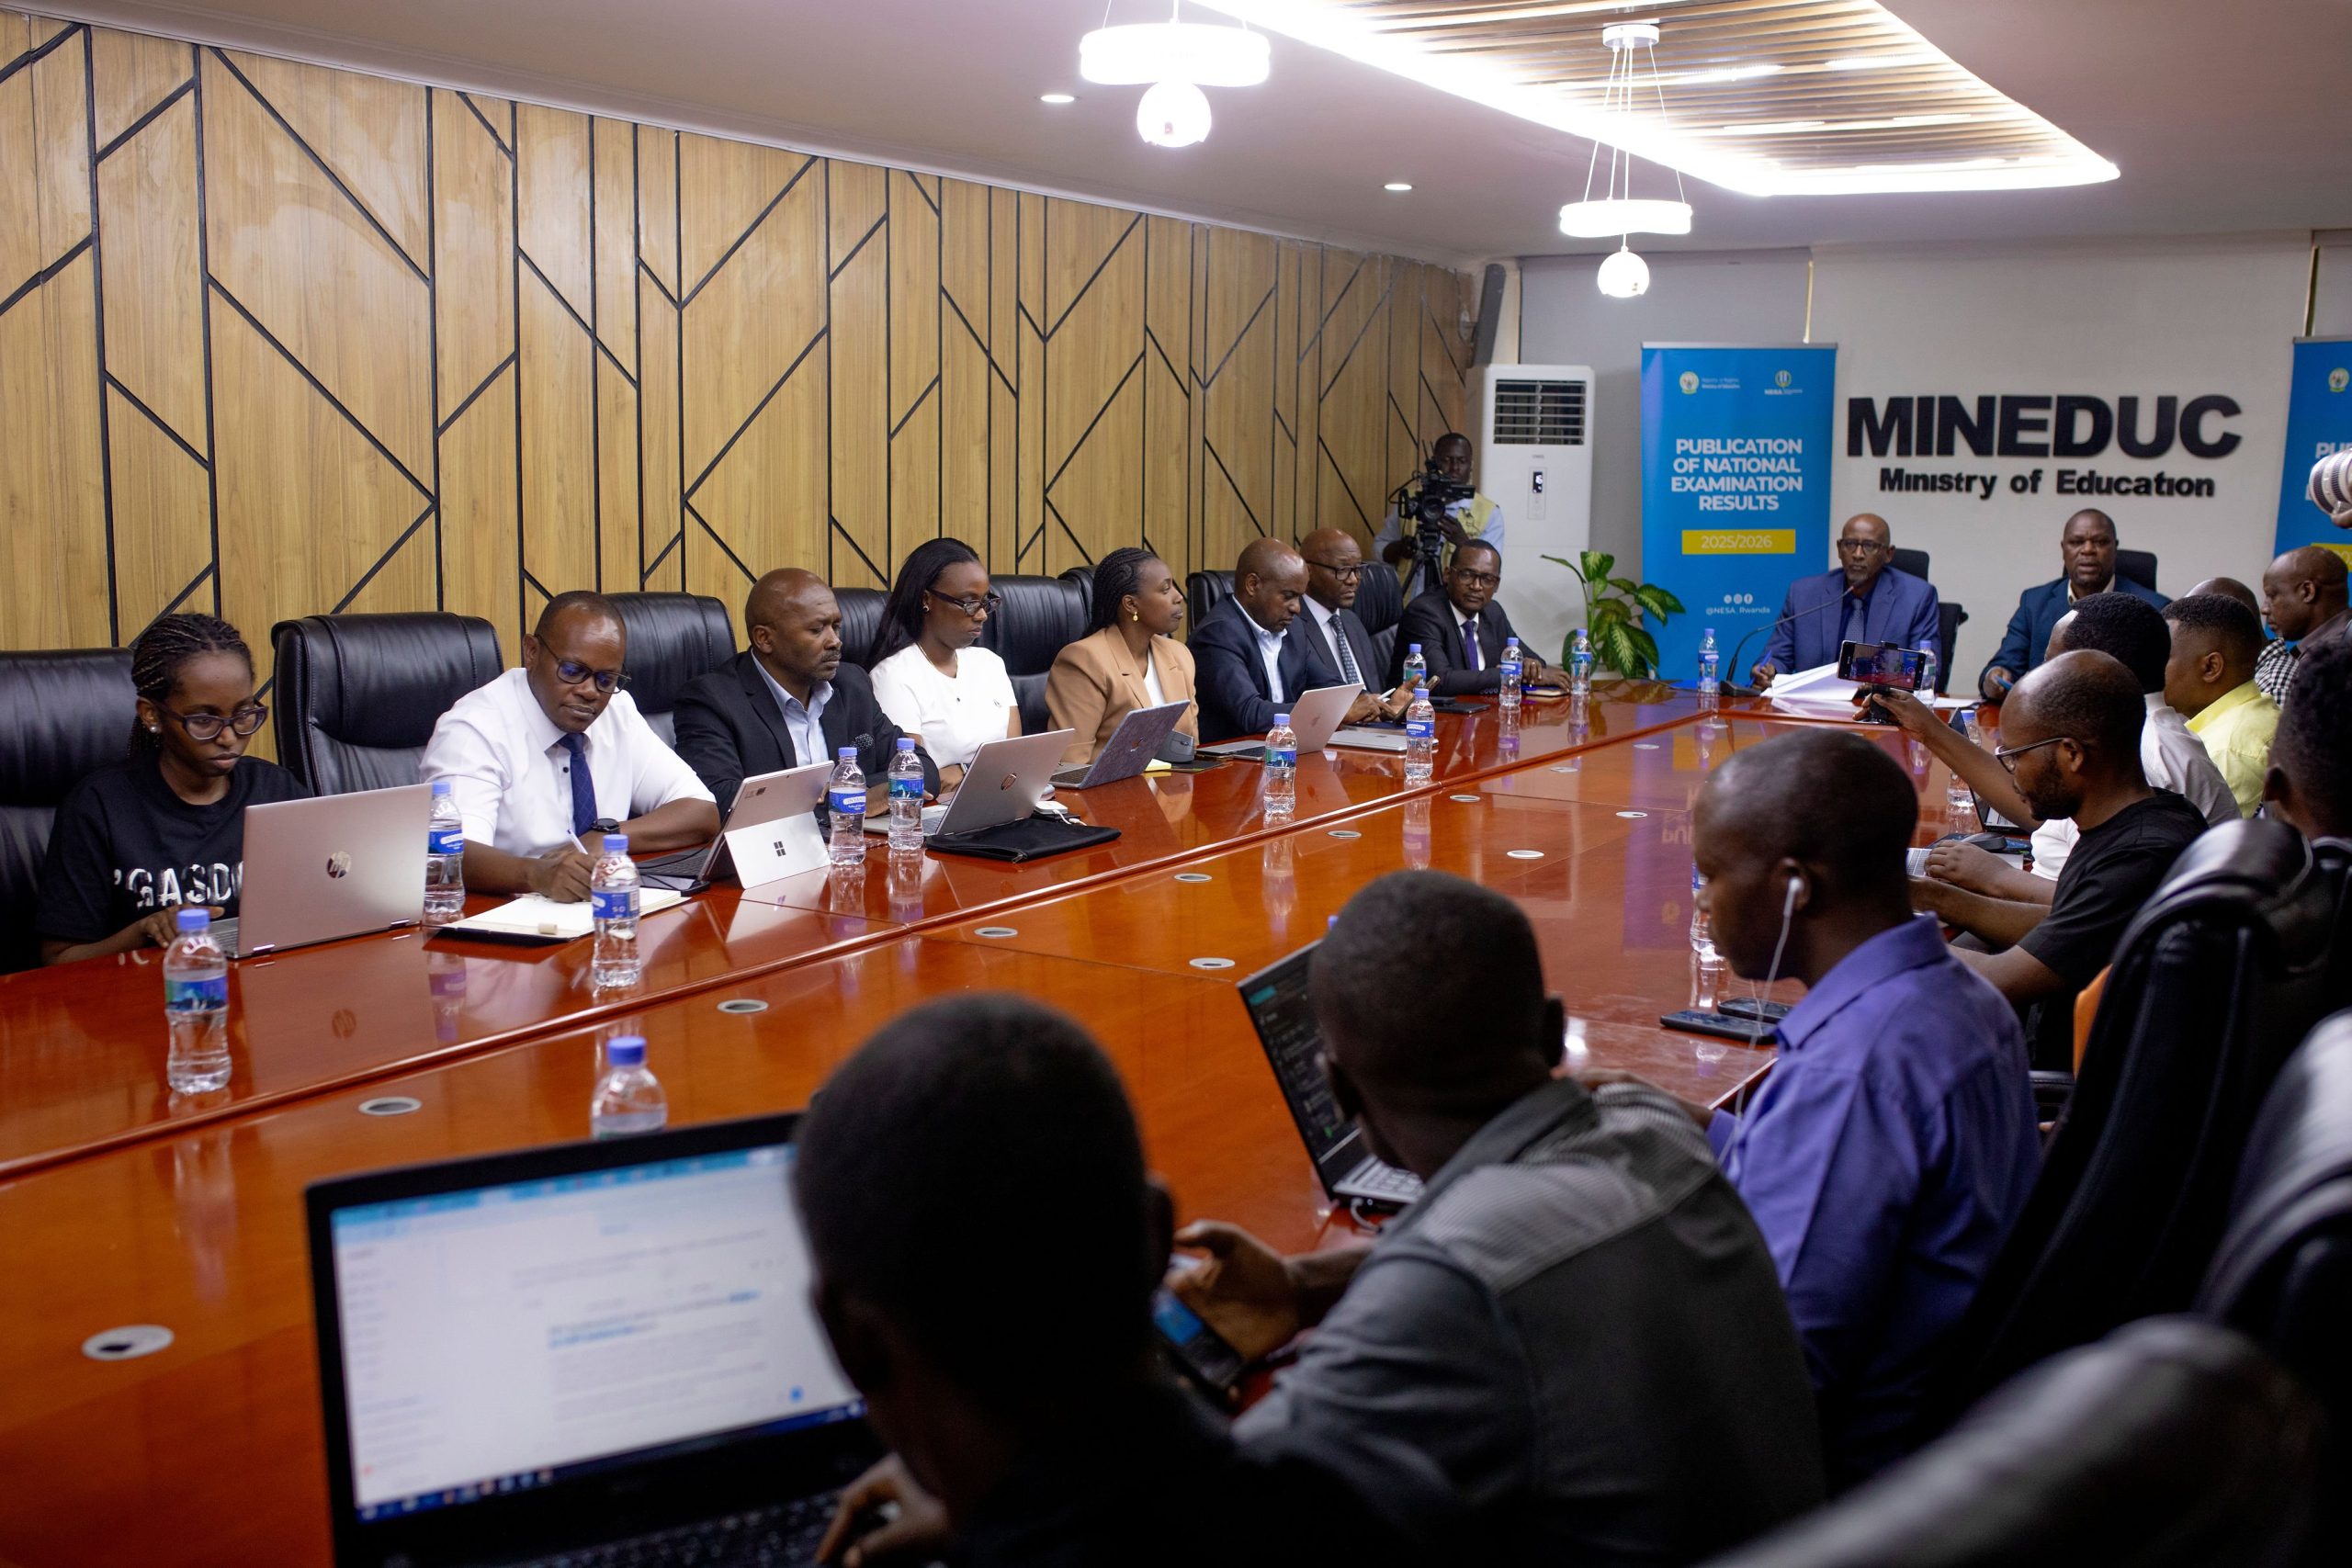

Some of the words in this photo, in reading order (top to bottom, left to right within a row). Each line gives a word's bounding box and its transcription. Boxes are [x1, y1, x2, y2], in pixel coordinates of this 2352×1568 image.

[1847, 394, 2243, 459] MINEDUC
[1675, 438, 1803, 455] PUBLICATION
[1673, 457, 1700, 473] OF
[1703, 457, 1801, 473] NATIONAL
[1671, 477, 1803, 492] EXAMINATION
[1879, 467, 1997, 500] Ministry
[2009, 468, 2043, 494] of
[2056, 469, 2215, 497] Education
[1699, 495, 1780, 511] RESULTS
[1701, 535, 1772, 548] 2025/2026
